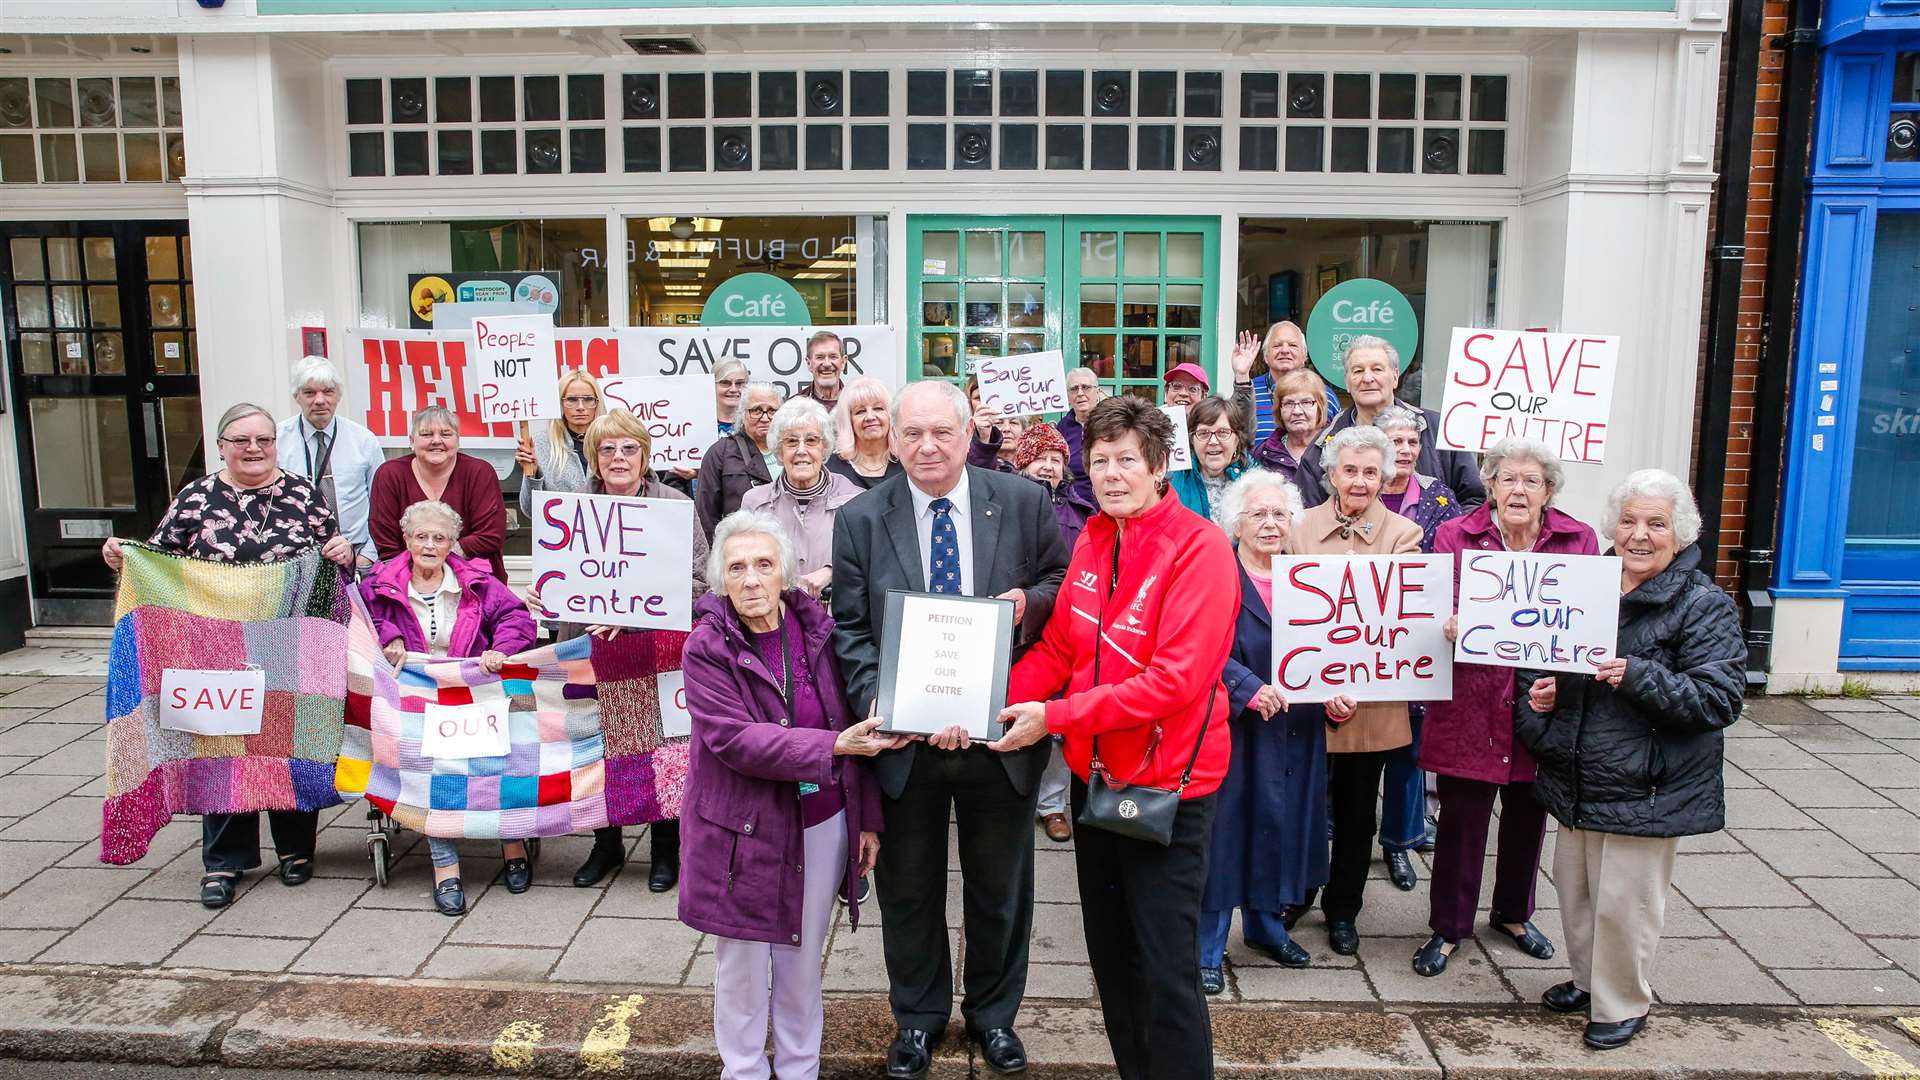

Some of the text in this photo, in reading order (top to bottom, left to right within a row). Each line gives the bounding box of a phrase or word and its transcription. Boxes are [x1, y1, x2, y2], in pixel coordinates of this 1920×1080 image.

[725, 294, 786, 318] Café
[1332, 300, 1394, 324] Café
[494, 358, 531, 378] NOT
[659, 338, 751, 376] SAVE
[768, 337, 864, 375] OR
[1454, 334, 1607, 396] SAVE
[981, 361, 1033, 384] Save
[363, 339, 514, 437] HEL
[1018, 379, 1056, 394] our
[481, 383, 538, 418] Profit
[604, 382, 671, 420] Save
[1491, 392, 1548, 414] OUR
[647, 422, 693, 440] our
[1443, 401, 1607, 463] CENTRE
[649, 446, 703, 463] ntre
[538, 499, 649, 557] SAVE
[580, 559, 630, 578] our
[1469, 555, 1567, 605] SAVE
[535, 570, 668, 619] Centre
[1288, 561, 1435, 626] SAVE
[928, 614, 973, 625] PETITION
[1511, 607, 1585, 631] our
[942, 632, 956, 642] TO
[1327, 625, 1409, 649] our
[1461, 625, 1608, 667] Centre
[934, 649, 960, 660] SAVE
[934, 667, 957, 678] OUR
[1278, 647, 1434, 691] Centre
[171, 687, 255, 711] SAVE
[925, 684, 963, 696] CENTRE
[438, 714, 500, 738] OUR
